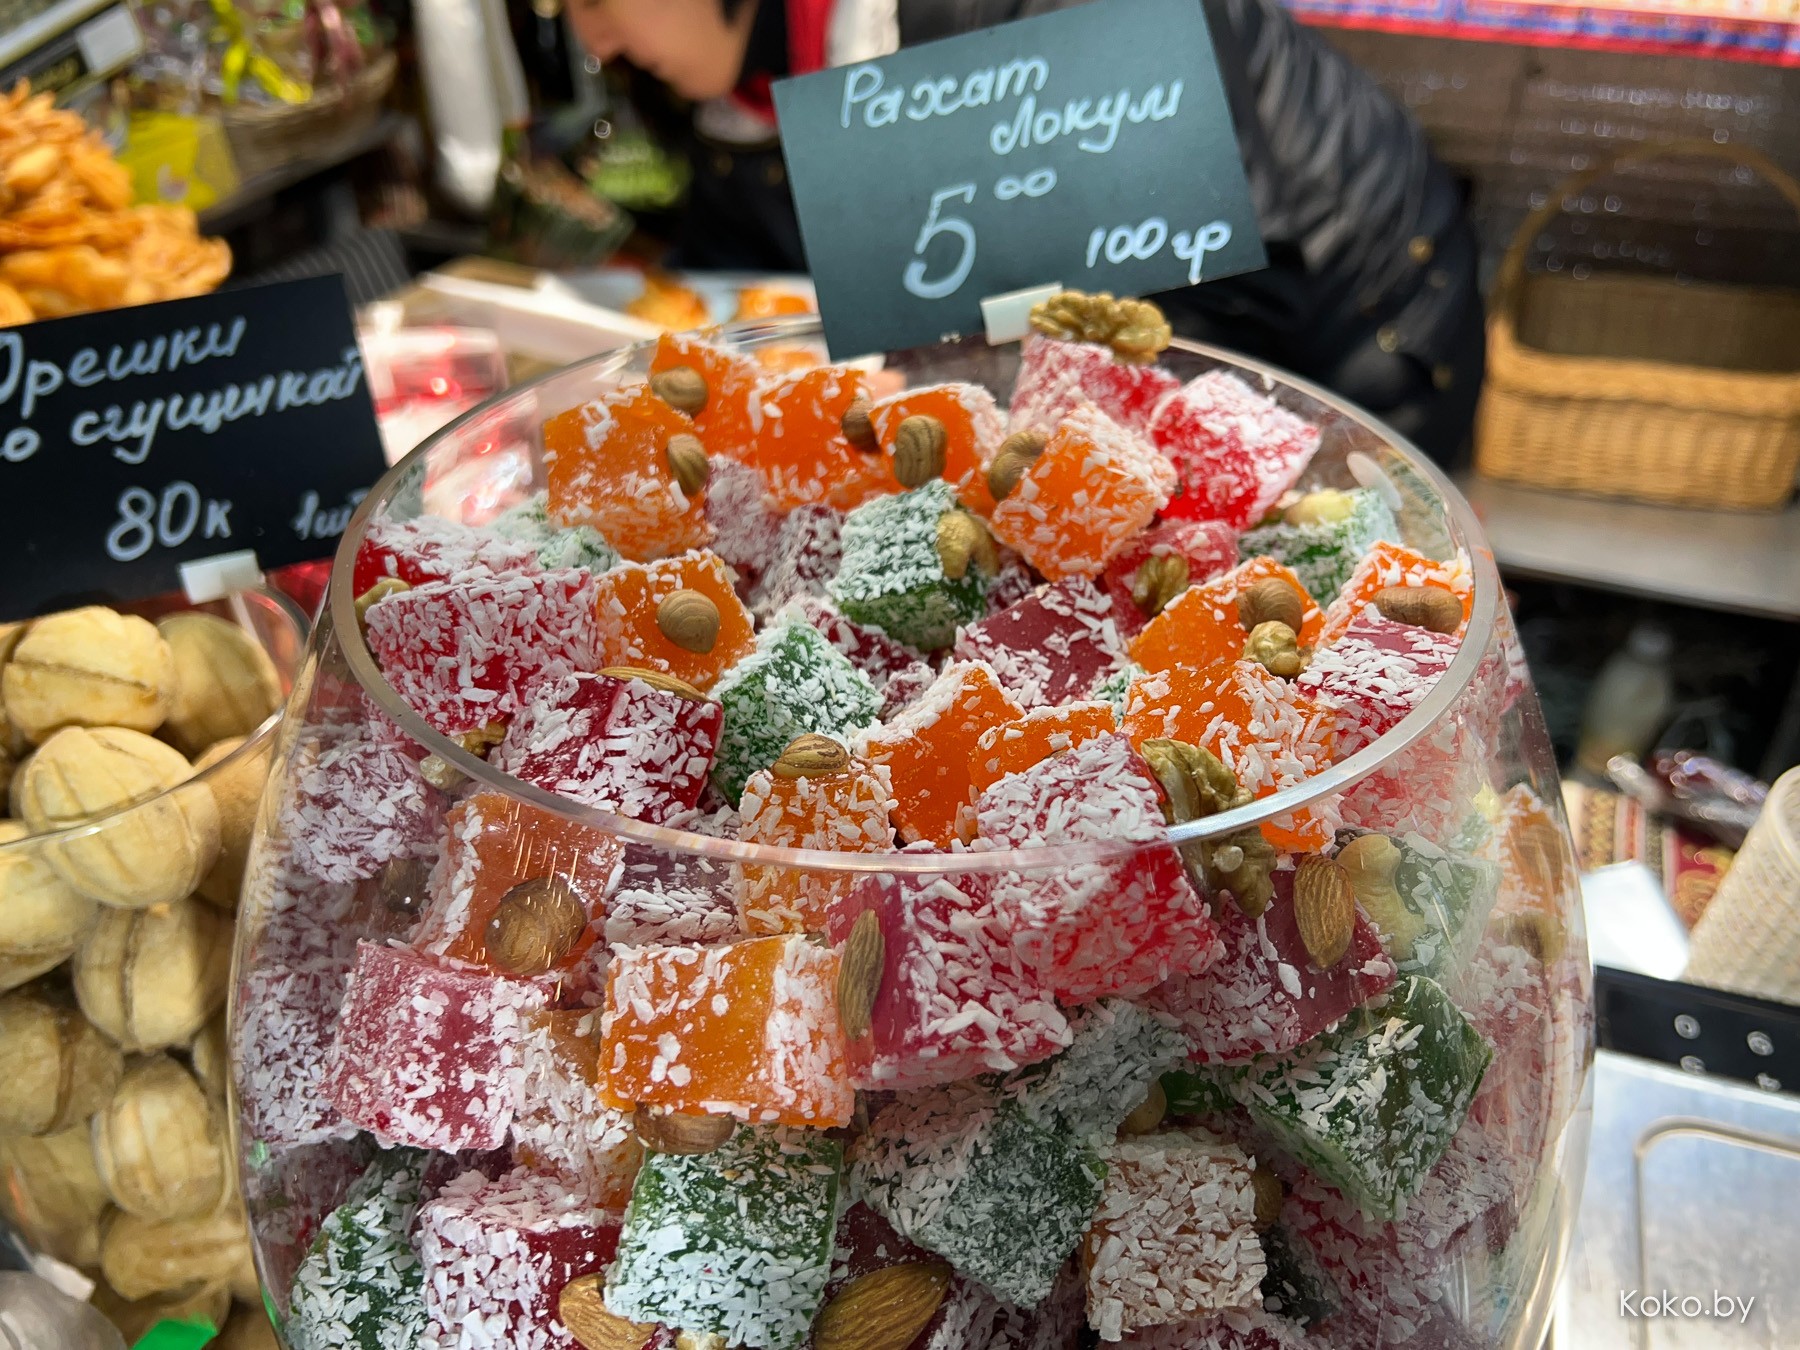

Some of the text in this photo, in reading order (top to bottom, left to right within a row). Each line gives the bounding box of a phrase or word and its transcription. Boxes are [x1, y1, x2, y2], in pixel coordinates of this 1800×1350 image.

[840, 55, 1049, 128] Рахат
[990, 79, 1184, 155] Локум
[0, 426, 41, 462] о
